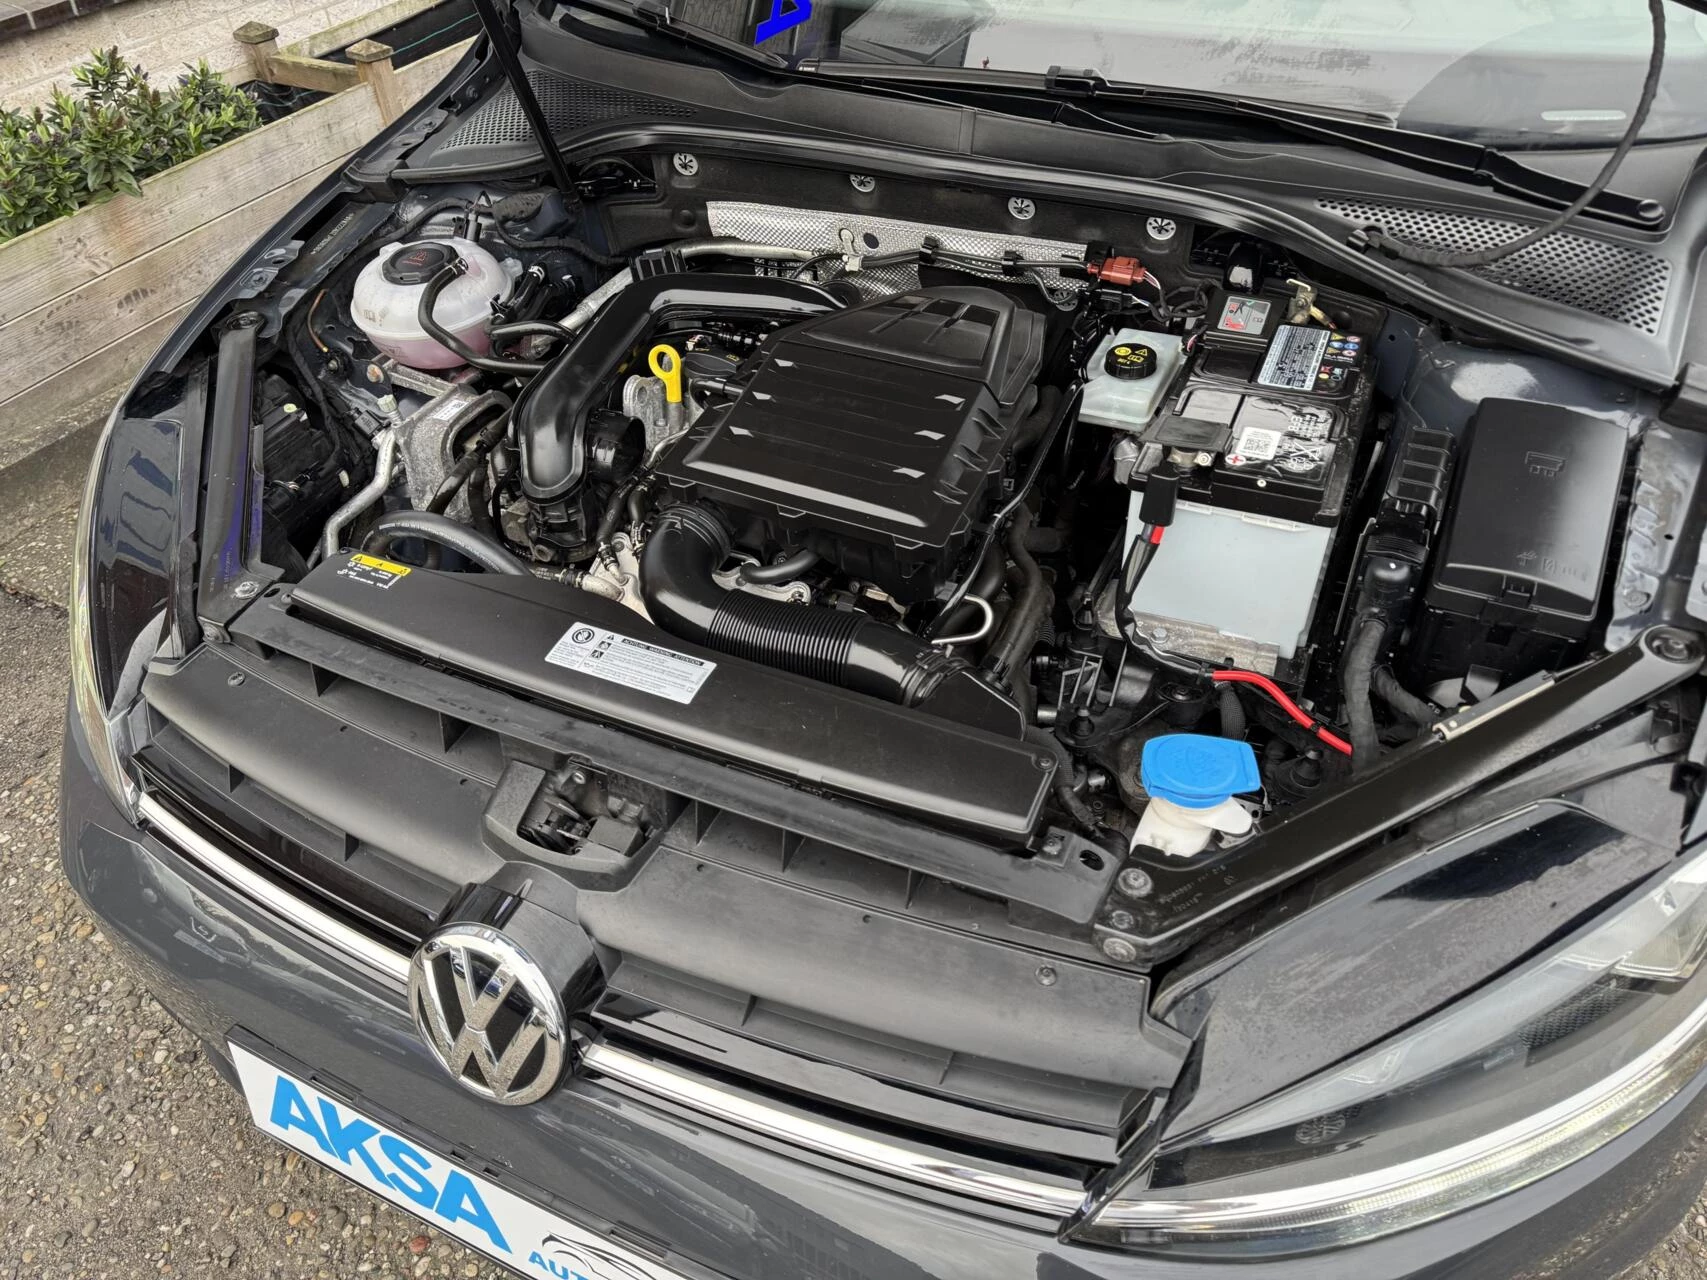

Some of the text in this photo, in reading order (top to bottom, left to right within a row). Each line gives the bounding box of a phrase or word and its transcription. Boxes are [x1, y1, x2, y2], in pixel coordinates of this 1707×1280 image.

[649, 645, 674, 657] WARNING
[674, 653, 703, 667] ATTENTION
[270, 1075, 513, 1254] AKSA
